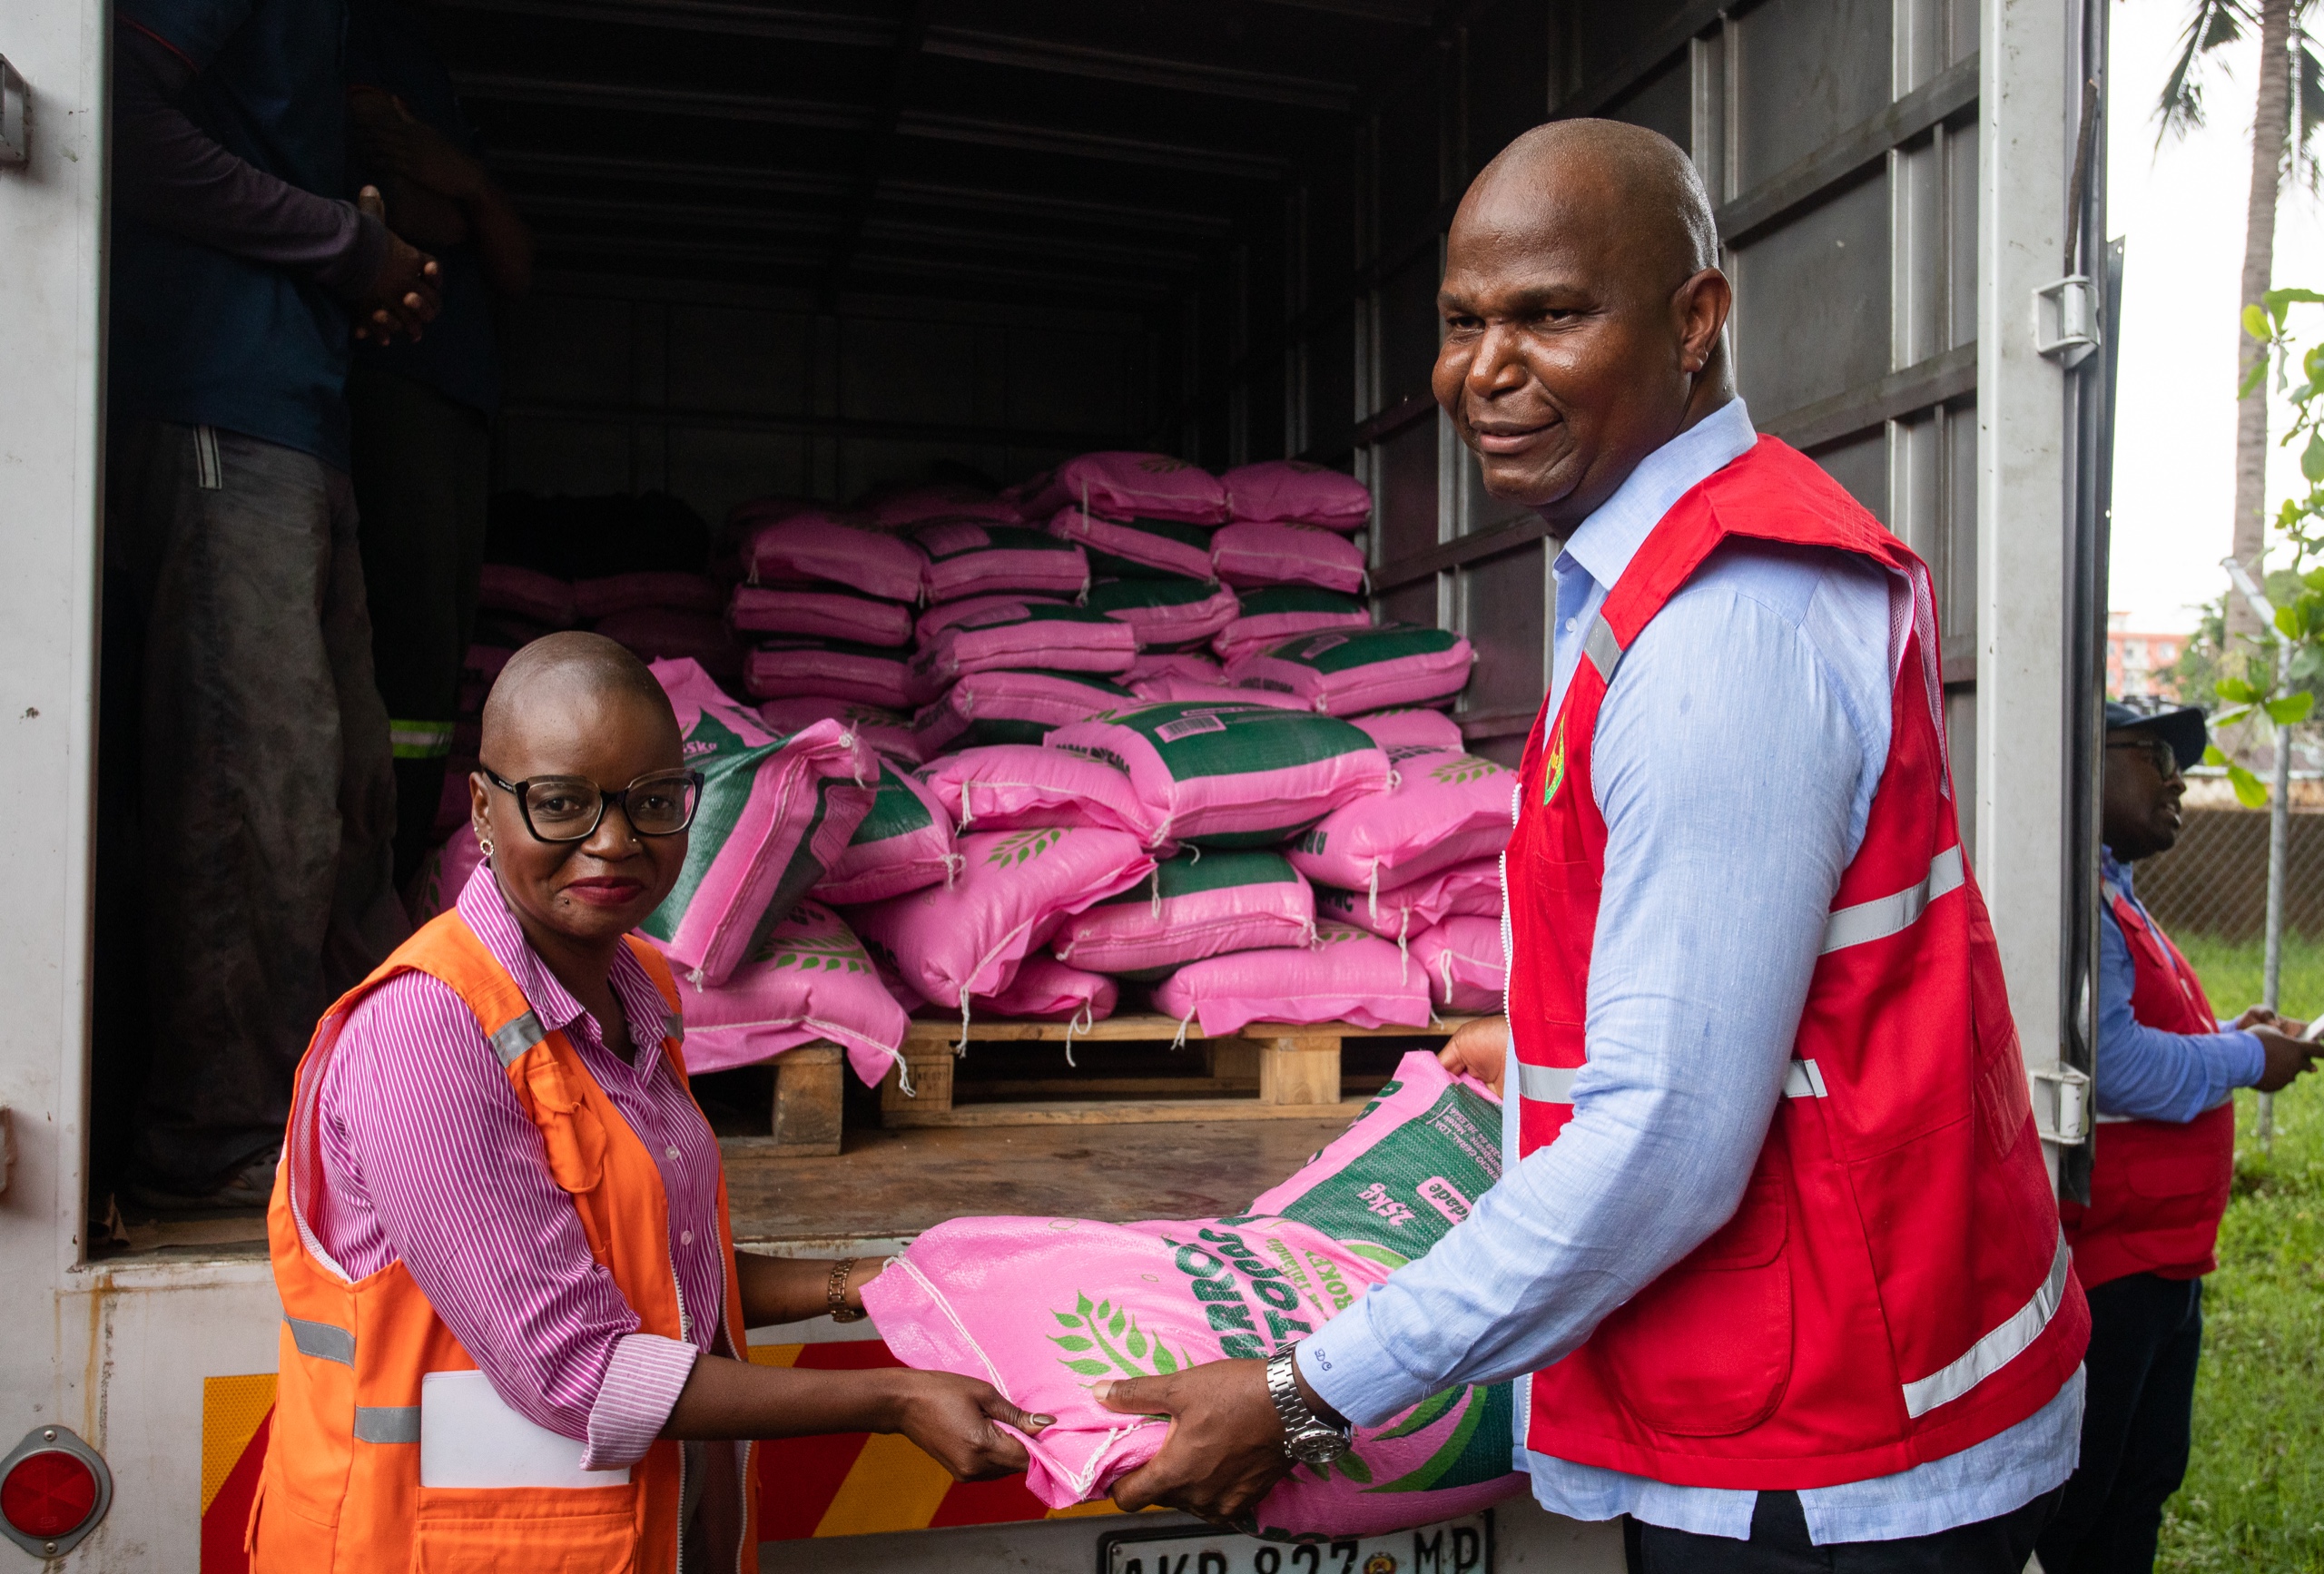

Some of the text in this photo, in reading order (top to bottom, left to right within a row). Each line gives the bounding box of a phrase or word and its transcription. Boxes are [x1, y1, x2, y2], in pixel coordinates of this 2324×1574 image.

[1435, 1121, 1452, 1136] LDA
[1475, 1156, 1500, 1181] ERCIO
[1356, 1183, 1416, 1226] 25kg
[1163, 1238, 1269, 1359] ARRO
[1301, 1248, 1354, 1311] ROKE
